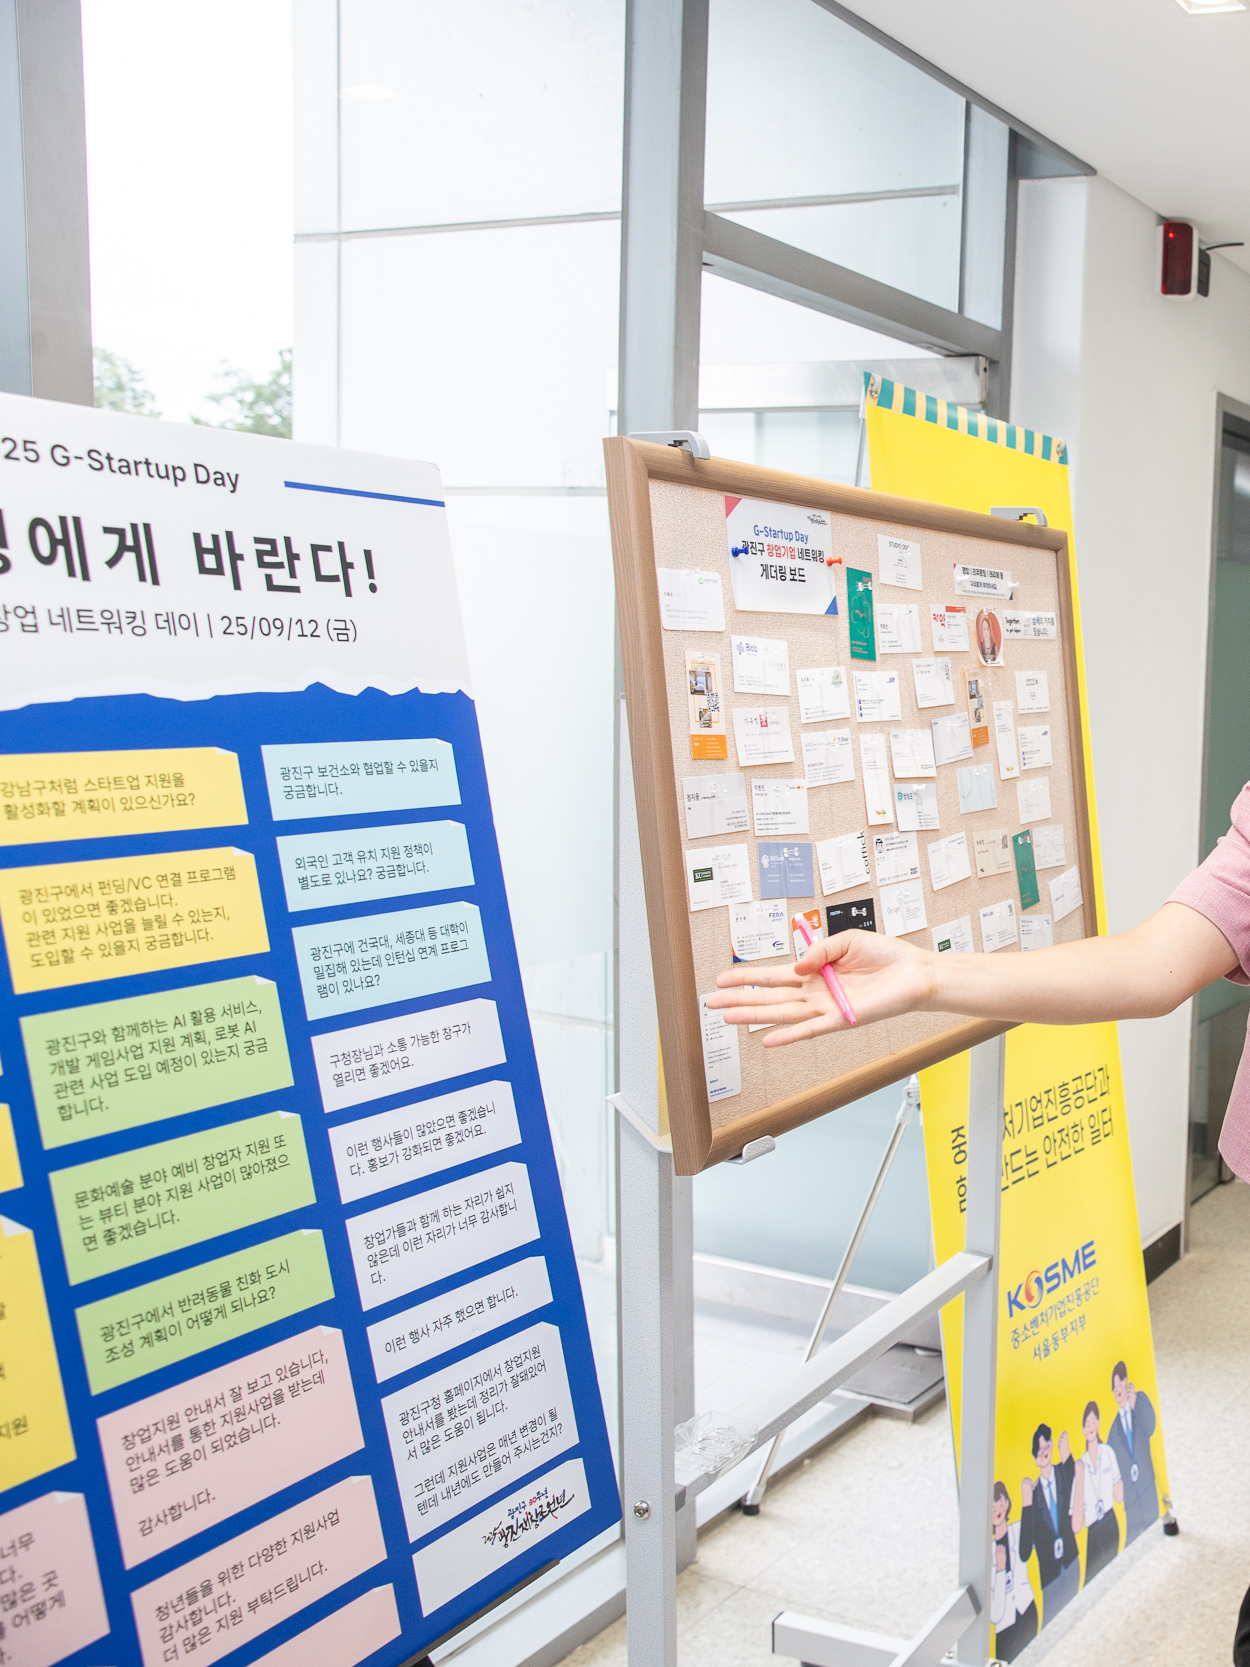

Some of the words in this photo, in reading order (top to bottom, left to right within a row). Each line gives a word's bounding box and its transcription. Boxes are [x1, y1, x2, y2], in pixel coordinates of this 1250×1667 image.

[50, 444, 186, 487] G-Startup
[194, 463, 239, 493] Day
[754, 525, 793, 542] G-Startup
[795, 531, 808, 544] Day
[767, 543, 796, 559] 창업기업
[797, 548, 824, 563] 네트워킹
[193, 530, 377, 598] 바란다!
[760, 564, 786, 581] 게더링
[790, 567, 806, 582] 보드
[48, 607, 146, 636] 네트워킹
[155, 611, 199, 637] 데이
[221, 616, 320, 641] 25/09/12
[326, 619, 357, 642] (금)
[1, 779, 78, 798] 강남구처럼
[84, 776, 140, 792] 스타트업
[145, 772, 185, 788] 지원을
[280, 766, 314, 781] 광진구
[318, 763, 360, 777] 보건소와
[364, 761, 394, 775] 협업할
[397, 760, 407, 773] 수
[410, 758, 439, 772] 있을지
[283, 782, 342, 799] 궁금합니다.
[4, 801, 66, 820] 활성화할
[72, 799, 116, 814] 계획이
[120, 793, 195, 811] 있으신가요?
[295, 855, 329, 871] 외국인
[332, 852, 353, 866] 고객
[357, 849, 377, 863] 유치
[381, 847, 400, 861] 지원
[404, 842, 433, 858] 정책이
[298, 874, 332, 890] 별도로
[335, 868, 373, 885] 있나요?
[376, 862, 429, 880] 궁금합니다.
[311, 942, 354, 961] 광진구에
[358, 936, 392, 953] 건국대,
[396, 930, 425, 946] 세종대
[428, 926, 437, 940] 등
[440, 921, 469, 938] 대학이
[314, 961, 347, 980] 밀집해
[350, 955, 382, 973] 있는데
[385, 948, 416, 966] 인턴십
[418, 944, 438, 960] 연계
[441, 940, 469, 954] 프로그
[317, 981, 339, 999] 램이
[342, 975, 380, 994] 있나요?
[330, 1043, 383, 1068] 구청장님과
[387, 1037, 408, 1053] 소통
[410, 1029, 440, 1048] 가능한
[443, 1022, 471, 1040] 창구가
[333, 1066, 366, 1088] 열리면
[369, 1057, 414, 1078] 좋겠어요.
[1043, 1121, 1085, 1169] 안전한
[1088, 1105, 1114, 1146] 일터
[74, 1179, 134, 1210] 문화예술
[140, 1168, 167, 1188] 분야
[172, 1159, 199, 1178] 예비
[202, 1147, 242, 1171] 창업자
[246, 1139, 270, 1157] 지원
[274, 1135, 286, 1147] 또
[79, 1215, 95, 1231] 는
[99, 1202, 128, 1224] 뷰티
[133, 1194, 161, 1213] 분야
[166, 1182, 193, 1204] 지원
[198, 1169, 237, 1193] 사업이
[364, 1219, 417, 1249] 창업가들과
[419, 1210, 440, 1230] 함께
[442, 1202, 462, 1219] 하는
[465, 1189, 493, 1211] 자리가
[83, 1236, 99, 1252] 면
[103, 1209, 180, 1245] 좋겠습니다.
[367, 1244, 400, 1268] 않은데
[403, 1235, 423, 1252] 이런
[426, 1223, 456, 1244] 자리가
[458, 1214, 478, 1231] 너무
[480, 1199, 517, 1224] 감사합니
[100, 1301, 175, 1342] 광진구에서
[178, 1281, 233, 1313] 반려동물
[236, 1269, 261, 1291] 친화
[265, 1259, 290, 1279] 도시
[371, 1271, 385, 1284] 다.
[1007, 1239, 1097, 1318] KOSME
[105, 1342, 135, 1364] 조성
[140, 1321, 183, 1349] 계획이
[186, 1305, 228, 1331] 어떻게
[230, 1286, 276, 1315] 되나요?
[385, 1336, 407, 1354] 이런
[409, 1327, 430, 1345] 행사
[433, 1315, 453, 1334] 자주
[455, 1300, 485, 1323] 했으면
[487, 1286, 519, 1310] 합니다.
[1011, 1276, 1100, 1350] 중소벤처기업진흥공단
[1032, 1314, 1087, 1361] 서울동부지부
[399, 1395, 441, 1427] 광진구청
[444, 1365, 503, 1403] 홈페이지에서
[505, 1344, 541, 1372] 창업지원
[403, 1412, 445, 1445] 안내서를
[448, 1396, 478, 1421] 봤는데
[480, 1379, 509, 1403] 정리가
[408, 1447, 418, 1461] 서
[420, 1434, 442, 1456] 많은
[444, 1415, 474, 1442] 도움이
[476, 1399, 508, 1425] 됩니다.
[414, 1468, 446, 1497] 그런데
[448, 1442, 497, 1477] 지원사업은
[498, 1429, 518, 1448] 매년
[520, 1413, 547, 1439] 변경이
[418, 1495, 439, 1517] 텐데
[441, 1470, 481, 1503] 내년에도
[482, 1453, 512, 1477] 만들어
[513, 1423, 563, 1460] 주시는건지?
[155, 1579, 213, 1622] 청년들을
[217, 1563, 245, 1587] 위한
[247, 1537, 288, 1570] 다양한
[290, 1508, 341, 1545] 지원사업
[159, 1590, 236, 1644] 감사합니다.
[163, 1646, 179, 1663] 더
[183, 1627, 212, 1654] 많은
[215, 1606, 243, 1636] 지원
[247, 1560, 328, 1614] 부탁드립니다.
